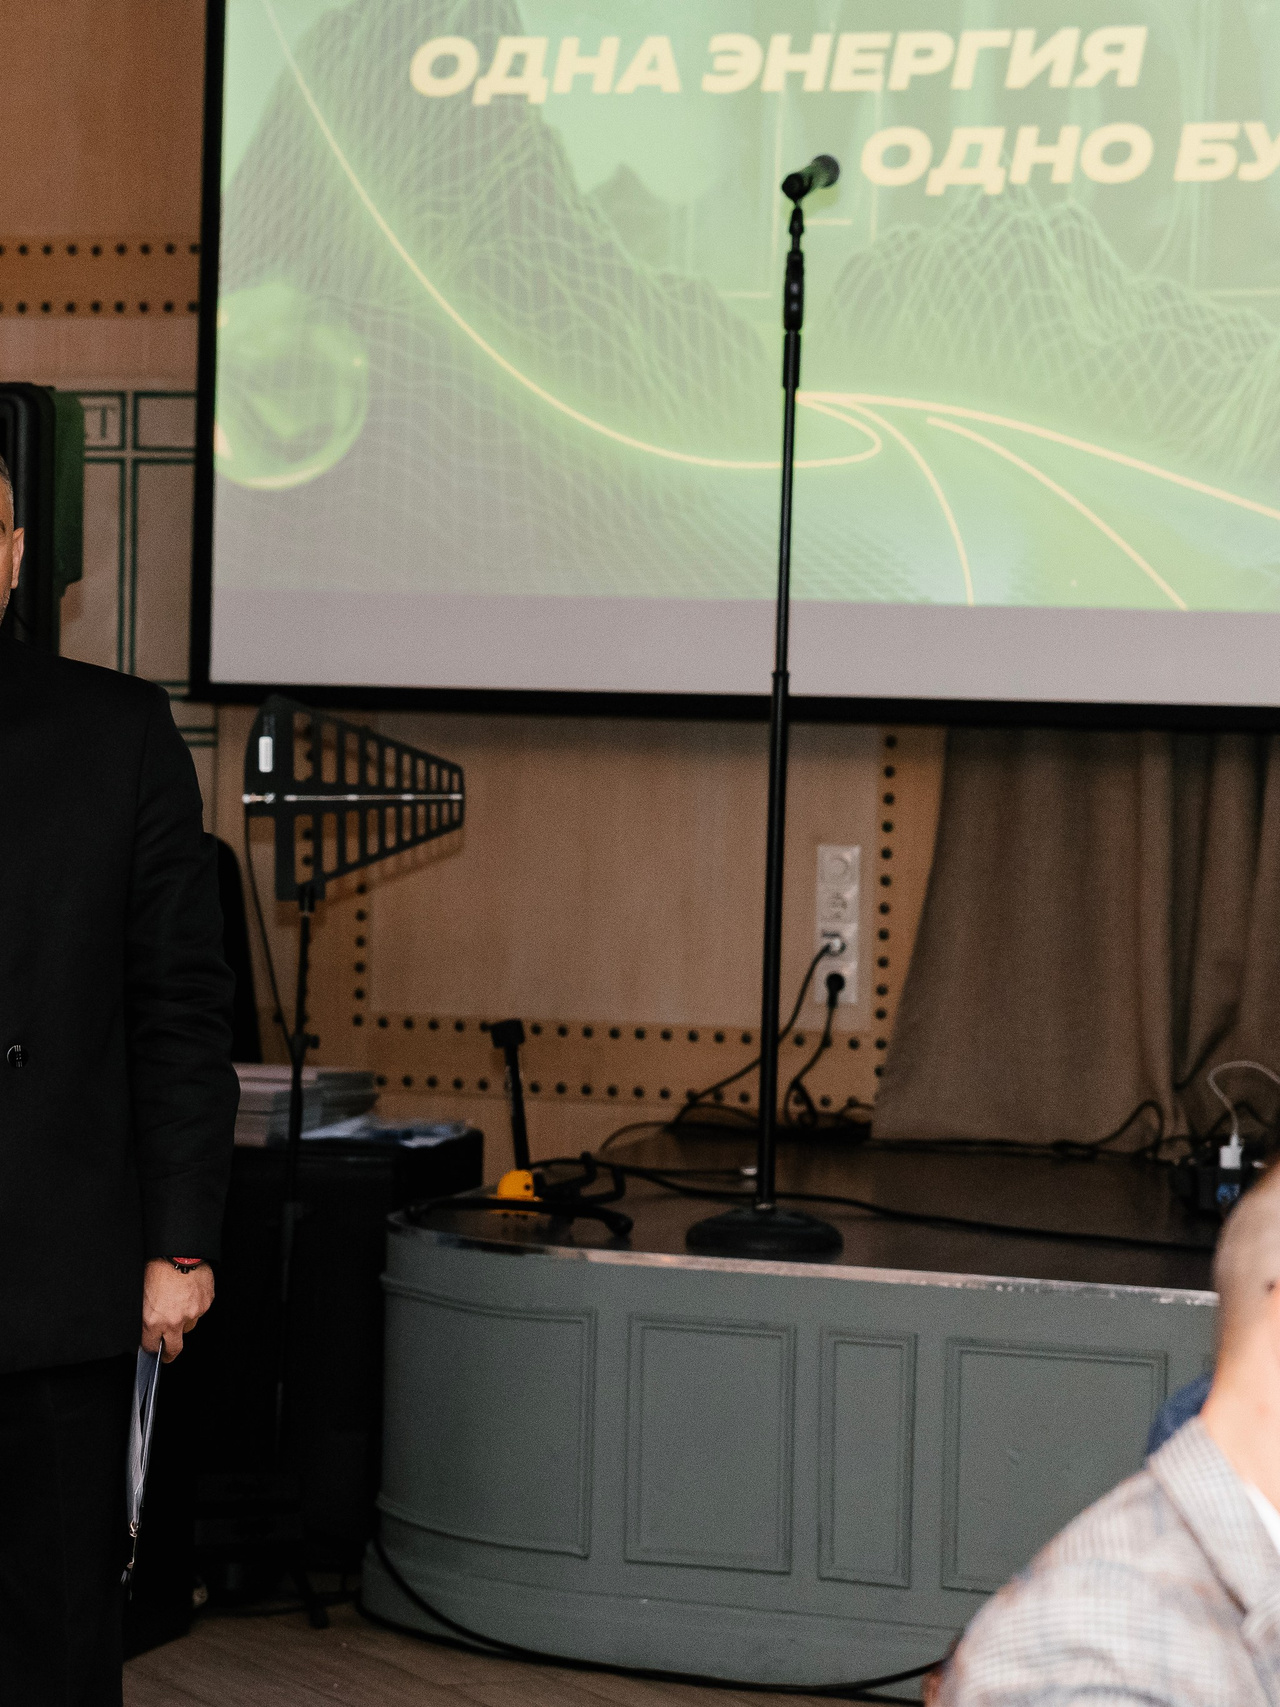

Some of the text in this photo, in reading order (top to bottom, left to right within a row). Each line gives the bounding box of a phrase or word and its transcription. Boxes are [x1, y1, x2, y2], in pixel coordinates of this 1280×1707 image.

[410, 26, 1148, 105] ОДНА ЭНЕРГИЯ
[860, 122, 1280, 195] ОДНО БУ
